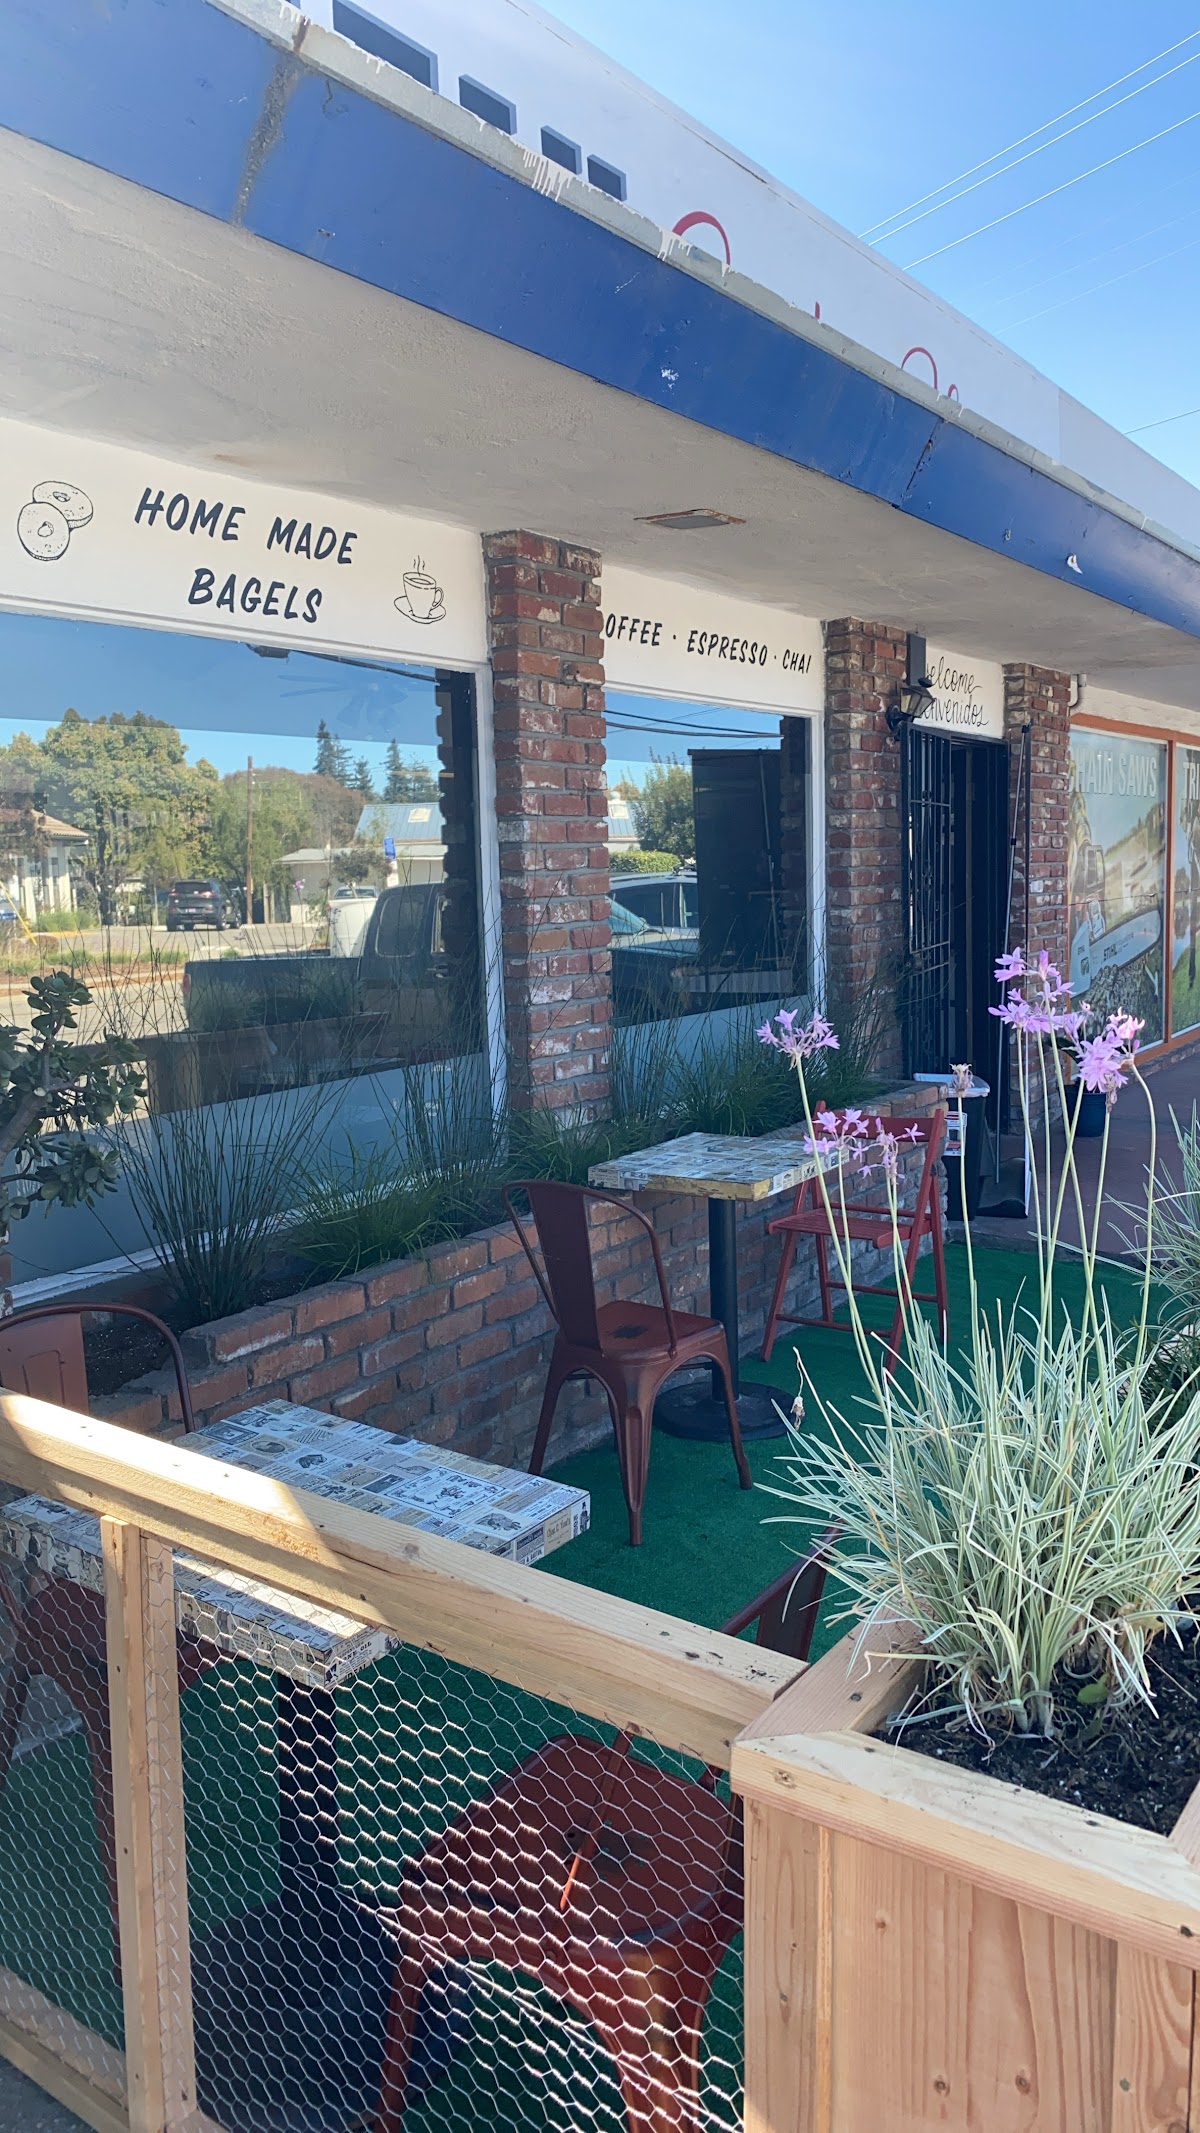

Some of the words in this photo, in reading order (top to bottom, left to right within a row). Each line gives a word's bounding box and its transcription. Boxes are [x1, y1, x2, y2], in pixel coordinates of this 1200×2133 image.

[134, 487, 246, 541] HOME
[266, 516, 358, 564] MADE
[187, 567, 323, 623] BAGELS
[605, 613, 663, 647] OFFEE
[686, 630, 768, 666] ESPRESSO
[782, 649, 812, 674] CHAI
[926, 656, 983, 694] elcome
[924, 695, 990, 727] envenidos
[1119, 753, 1157, 798] SAWS
[1182, 761, 1200, 800] TRI
